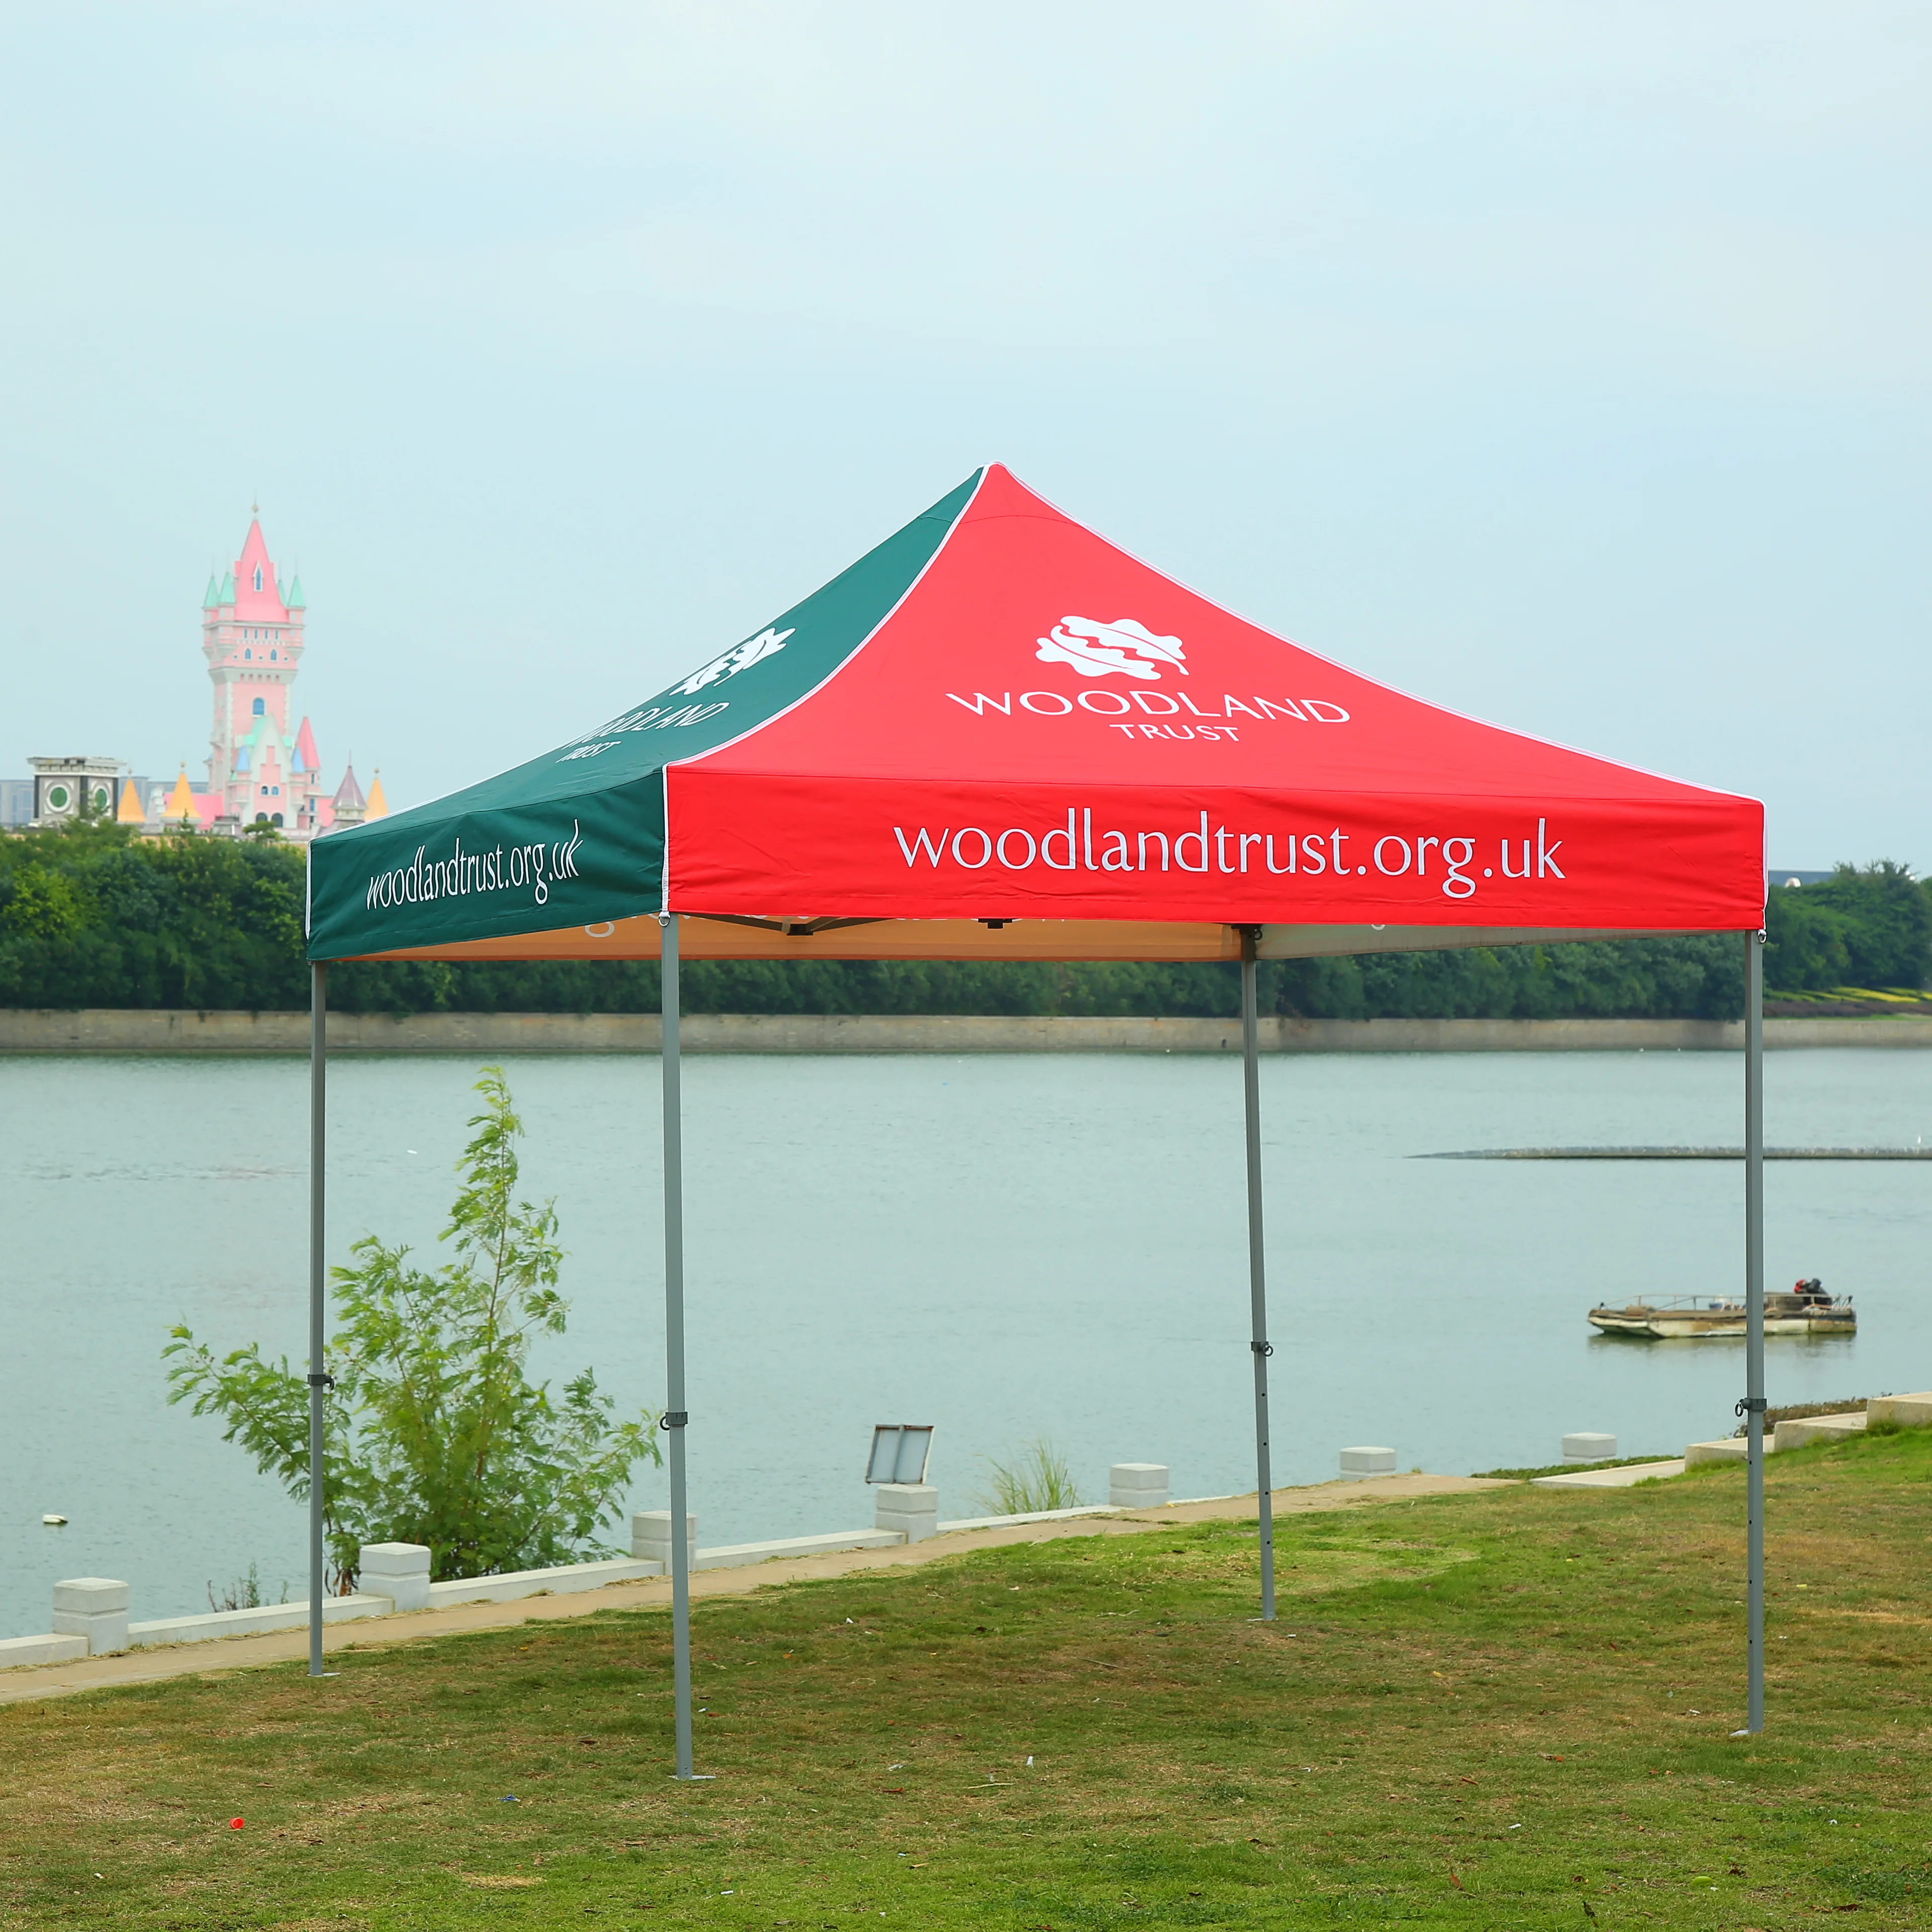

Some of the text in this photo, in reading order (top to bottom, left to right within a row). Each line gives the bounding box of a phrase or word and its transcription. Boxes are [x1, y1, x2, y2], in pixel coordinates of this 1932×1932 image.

[944, 690, 1351, 723] WOODLAND
[1108, 723, 1240, 742] TRUST
[555, 741, 622, 763] TRUST
[366, 818, 584, 911] woodlandtrust.org.uk
[893, 807, 1567, 899] woodlandtrust.org.uk
